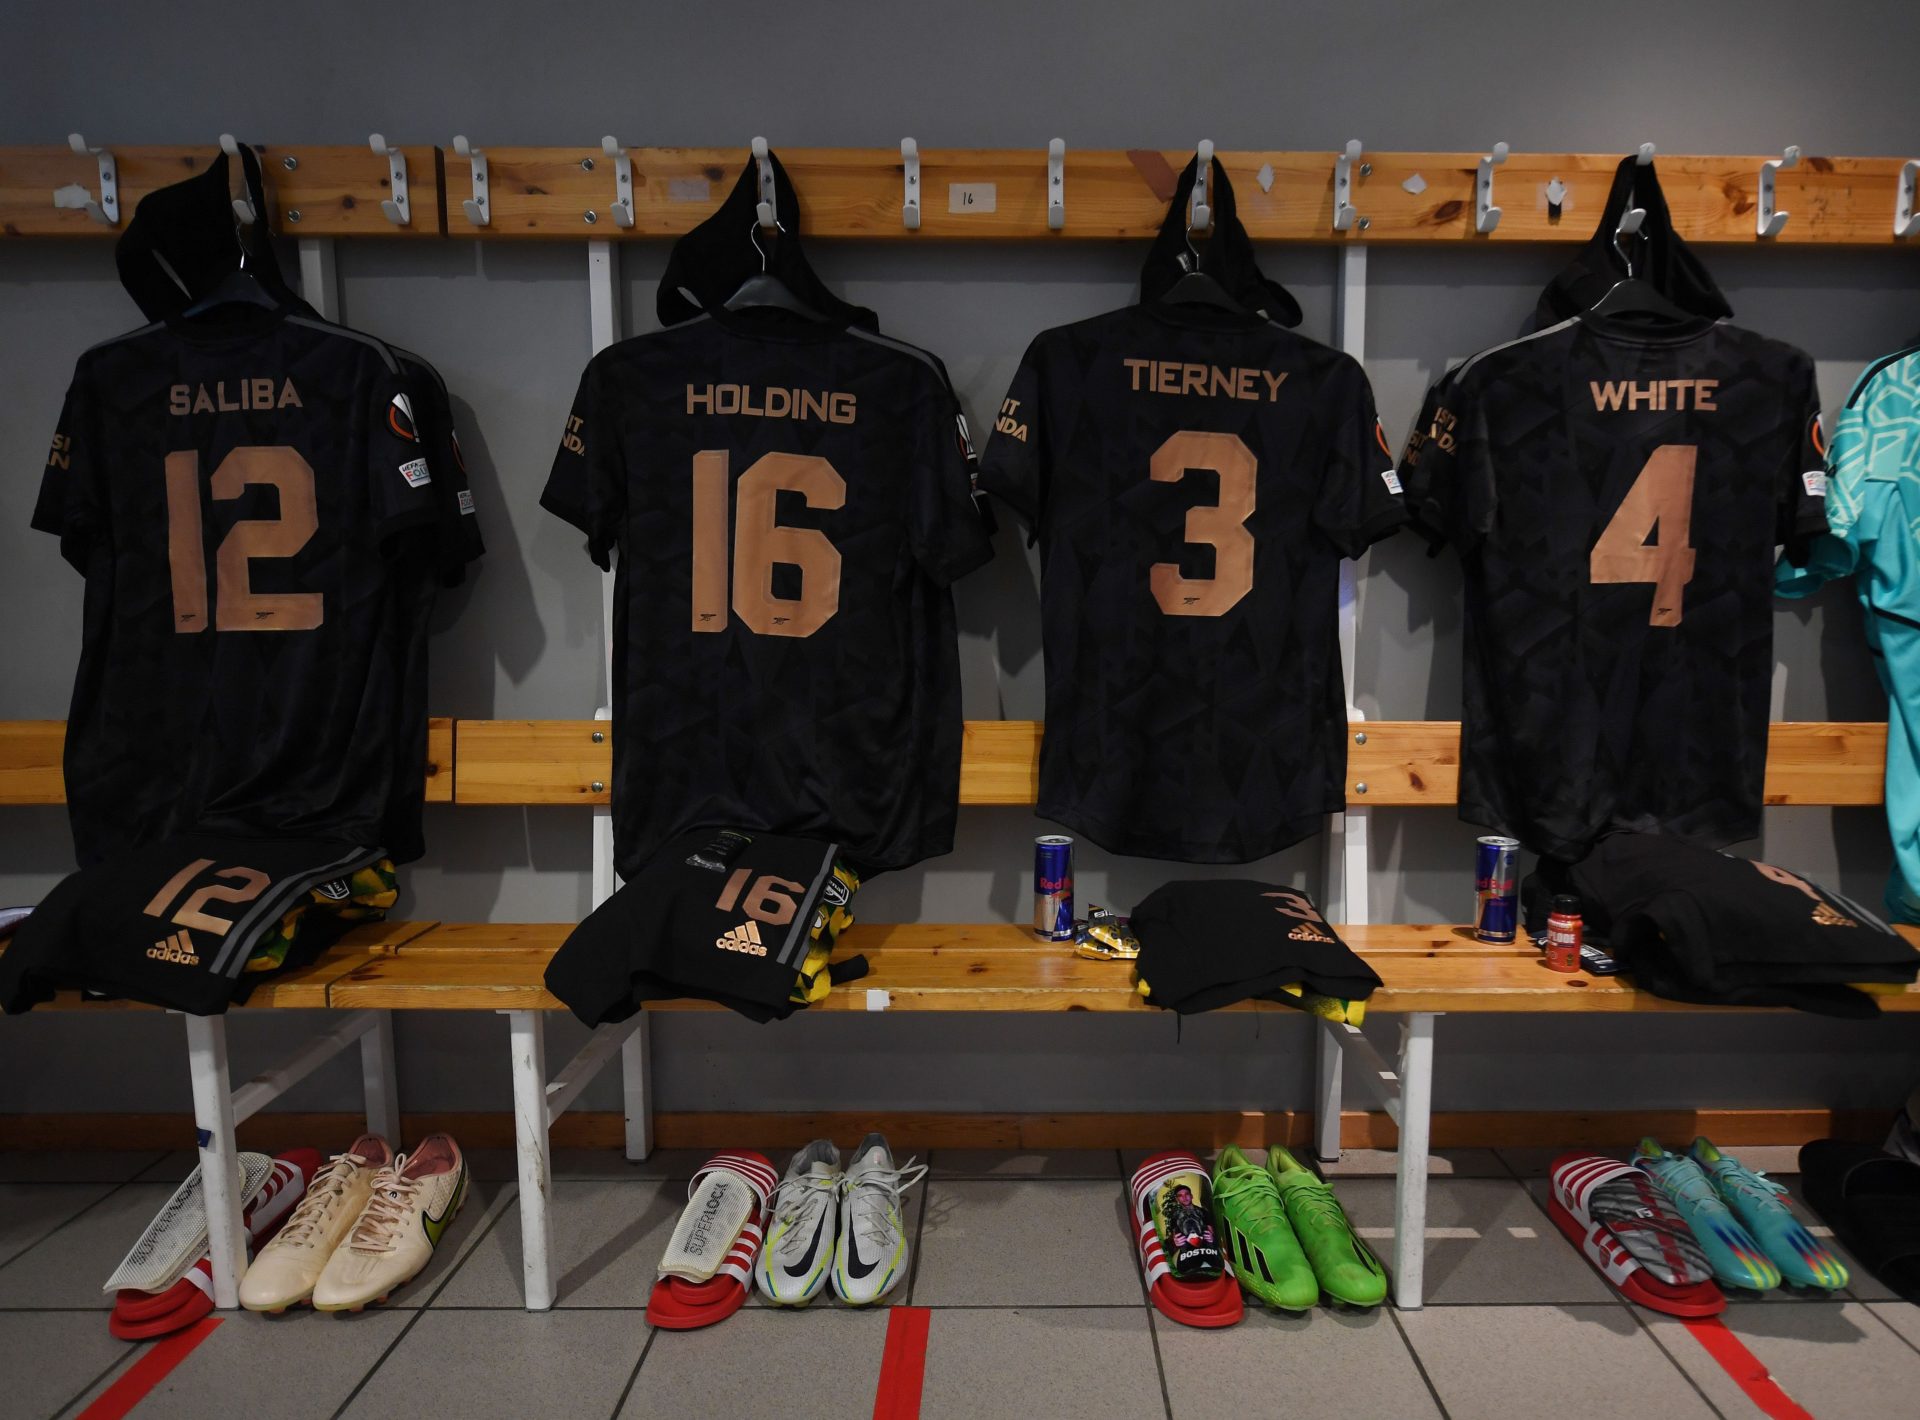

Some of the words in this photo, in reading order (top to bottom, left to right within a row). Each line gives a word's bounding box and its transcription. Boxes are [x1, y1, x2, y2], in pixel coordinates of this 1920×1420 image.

[963, 191, 974, 206] 16
[169, 377, 304, 417] SALIBA
[1123, 358, 1289, 402] TIERNEY
[1590, 379, 1719, 411] WHITE
[686, 383, 857, 425] HOLDING
[164, 446, 324, 633] 12
[692, 449, 846, 638] 16
[1150, 430, 1258, 617] 3
[1590, 444, 1698, 627] 4
[143, 858, 272, 936] 12
[715, 868, 806, 926] 16
[1260, 892, 1323, 923] 3
[146, 947, 200, 966] adidas
[716, 937, 768, 957] adidas
[1287, 932, 1336, 944] adidas
[1179, 1247, 1218, 1262] BOSTON
